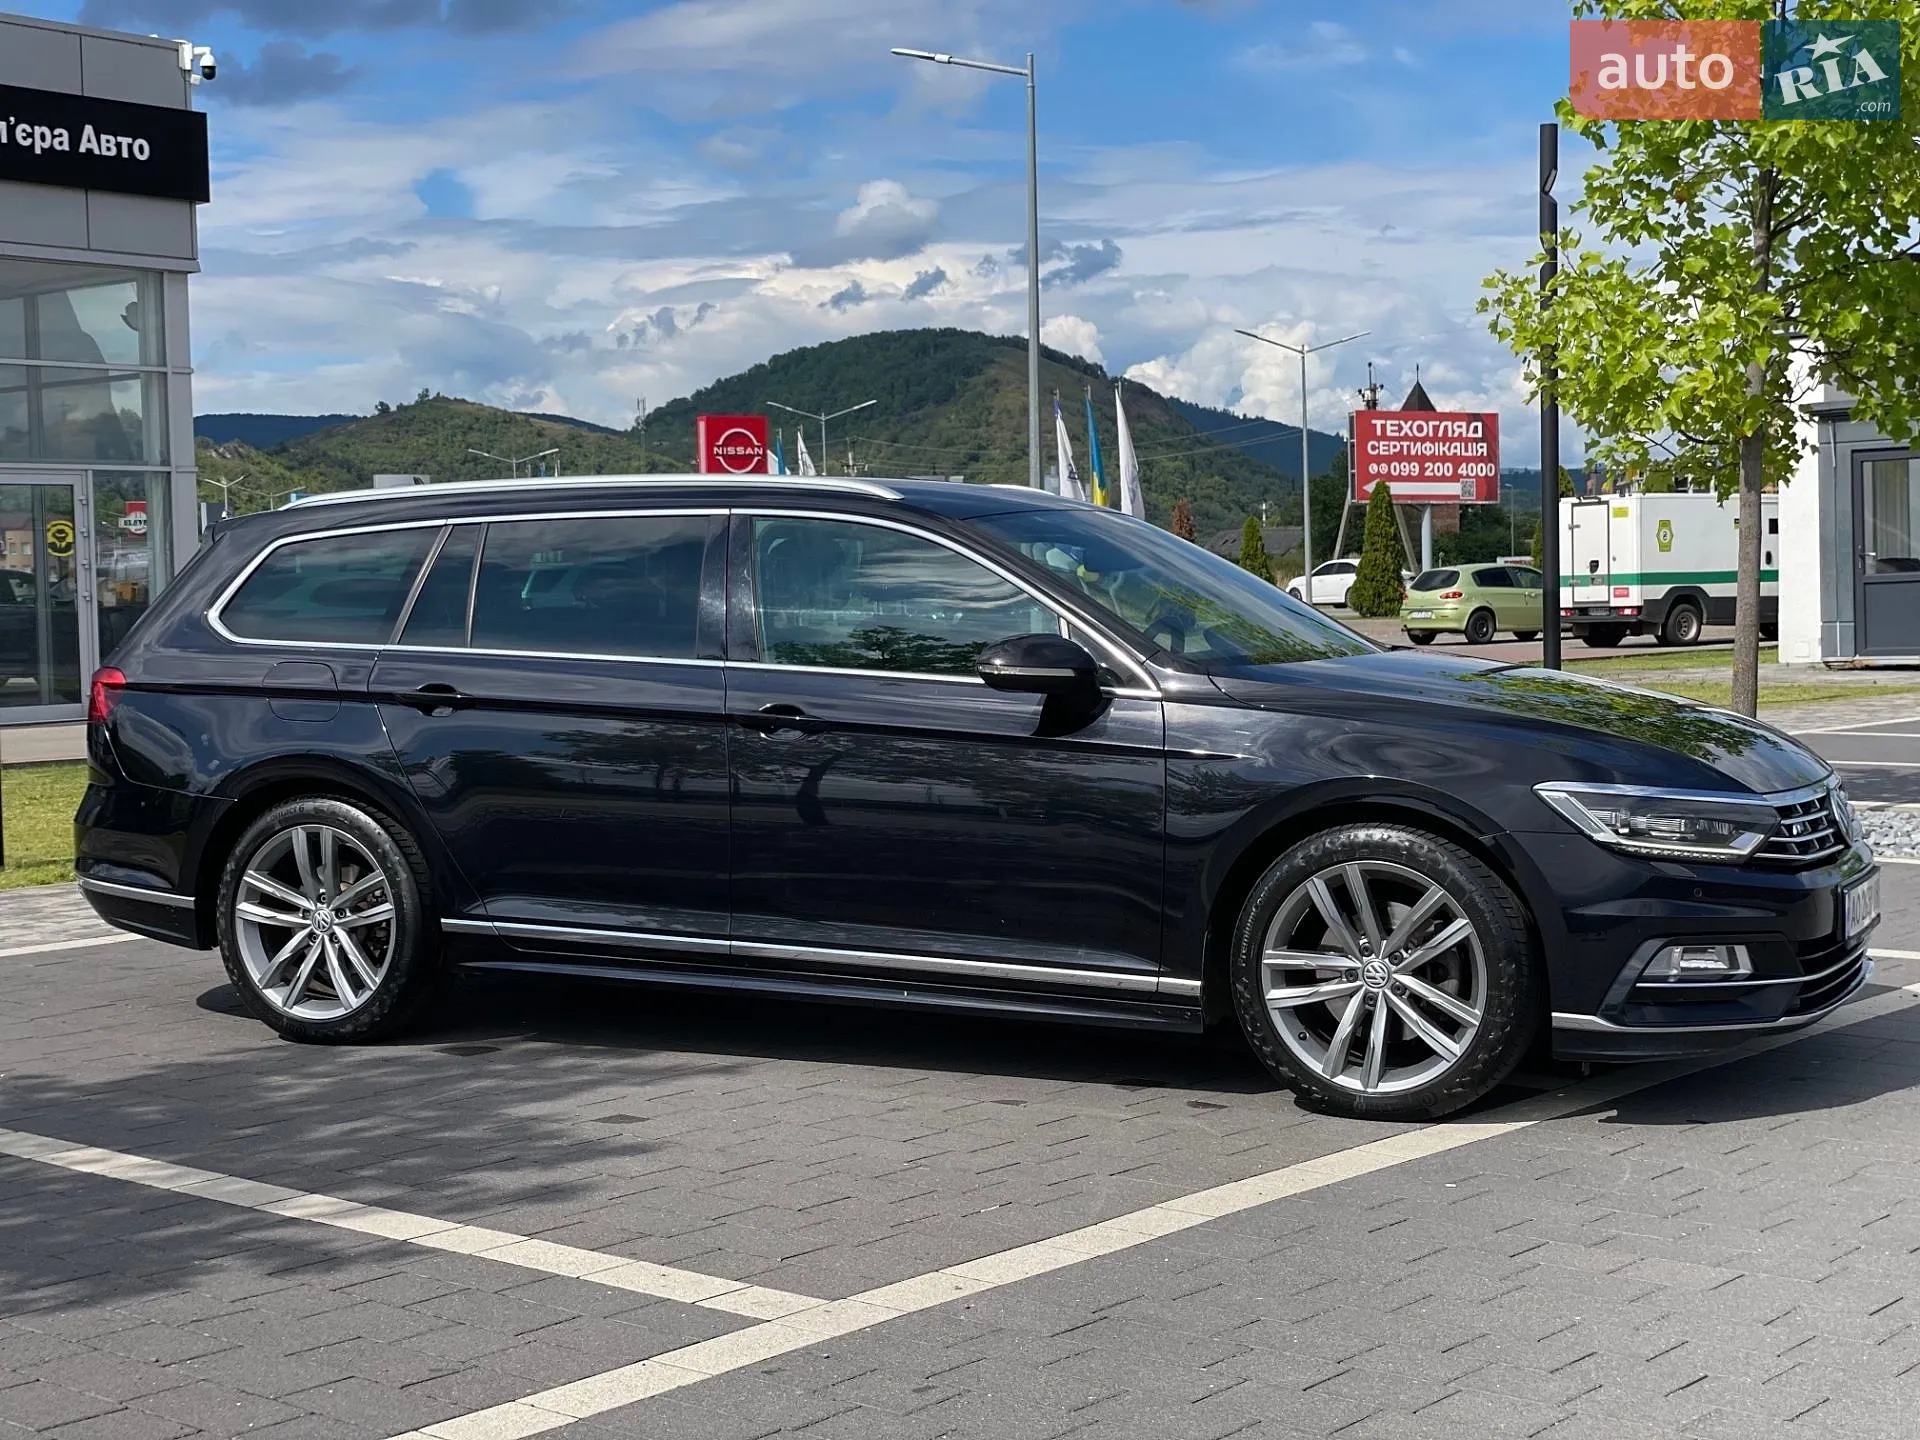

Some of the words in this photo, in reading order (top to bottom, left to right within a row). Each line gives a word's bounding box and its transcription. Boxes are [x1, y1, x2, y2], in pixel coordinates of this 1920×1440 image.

[79, 124, 150, 161] Авто
[1371, 419, 1483, 438] ТЕХОГЛЯД
[713, 446, 763, 455] NISSAN
[1367, 440, 1488, 457] СЕРТИФІКАЦІЯ
[1390, 462, 1420, 477] 099
[1424, 462, 1454, 477] 200
[1457, 462, 1496, 477] 4000
